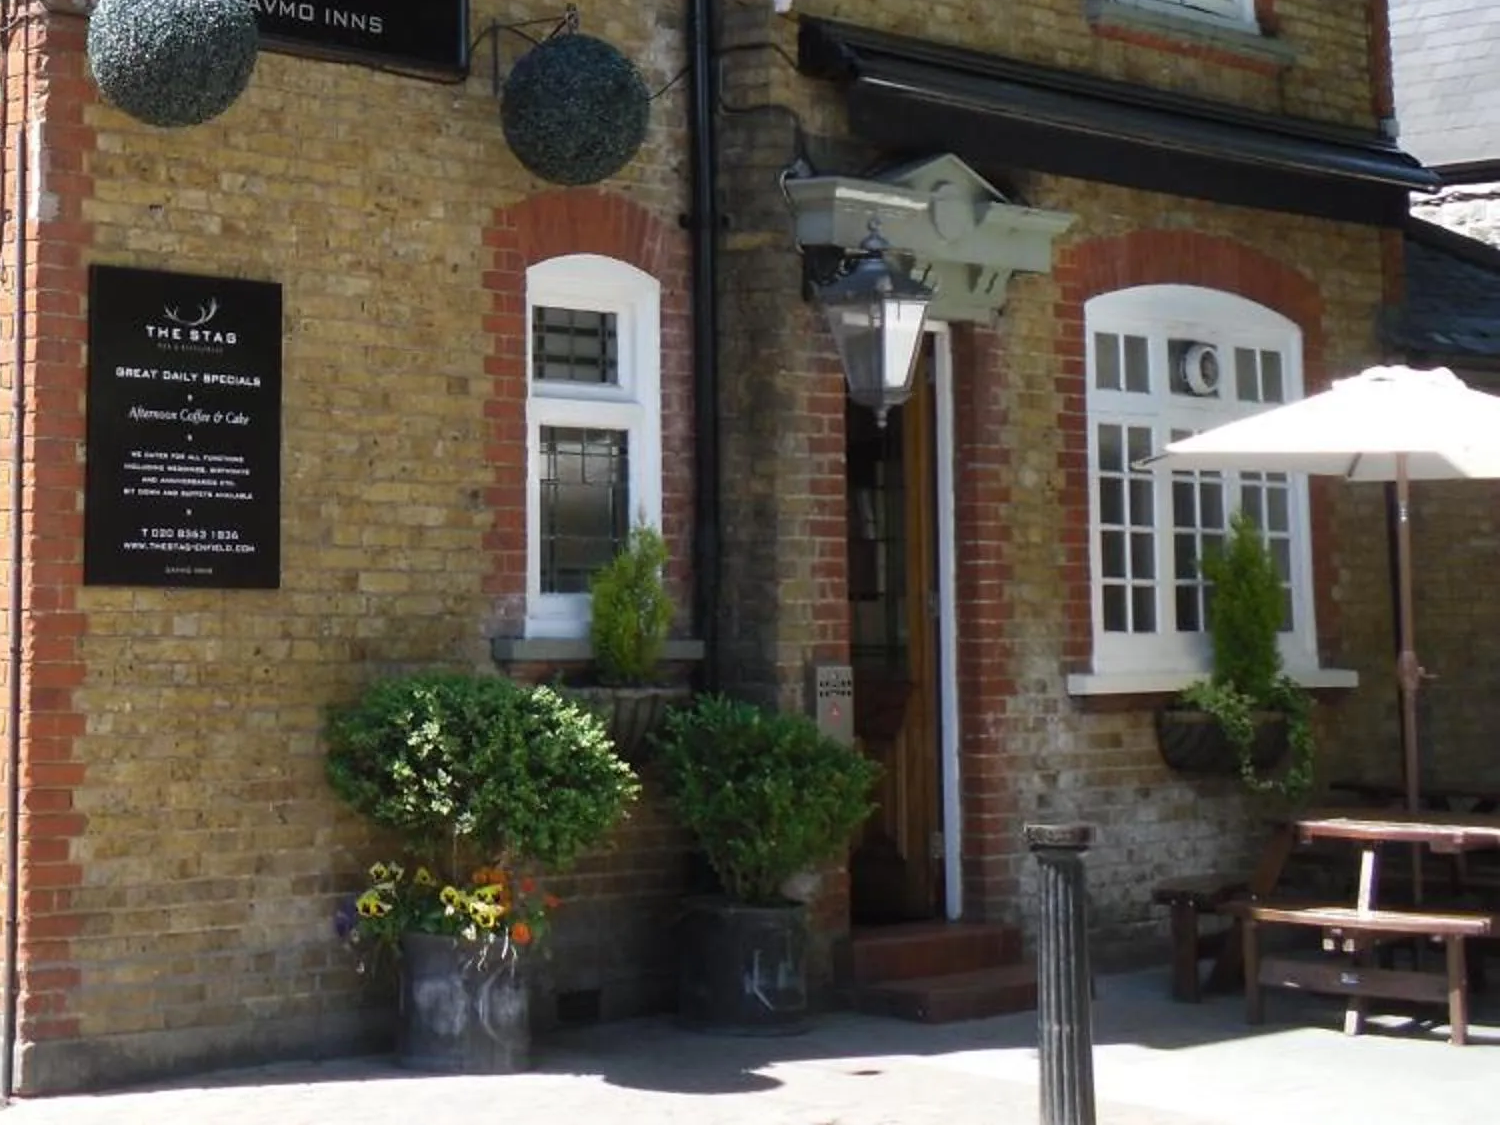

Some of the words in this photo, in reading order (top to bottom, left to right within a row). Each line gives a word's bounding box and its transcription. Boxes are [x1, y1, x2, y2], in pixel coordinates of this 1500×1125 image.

[325, 8, 384, 34] INNS
[145, 325, 182, 340] THE
[189, 329, 238, 344] STAG
[115, 366, 159, 379] GREAT
[162, 370, 199, 383] DAILY
[203, 373, 261, 387] SPECIALS
[128, 405, 178, 423] Afternoon
[179, 408, 211, 425] Coffee
[213, 410, 224, 423] &
[225, 411, 250, 425] Cake
[141, 528, 149, 538] T
[151, 528, 175, 538] 020
